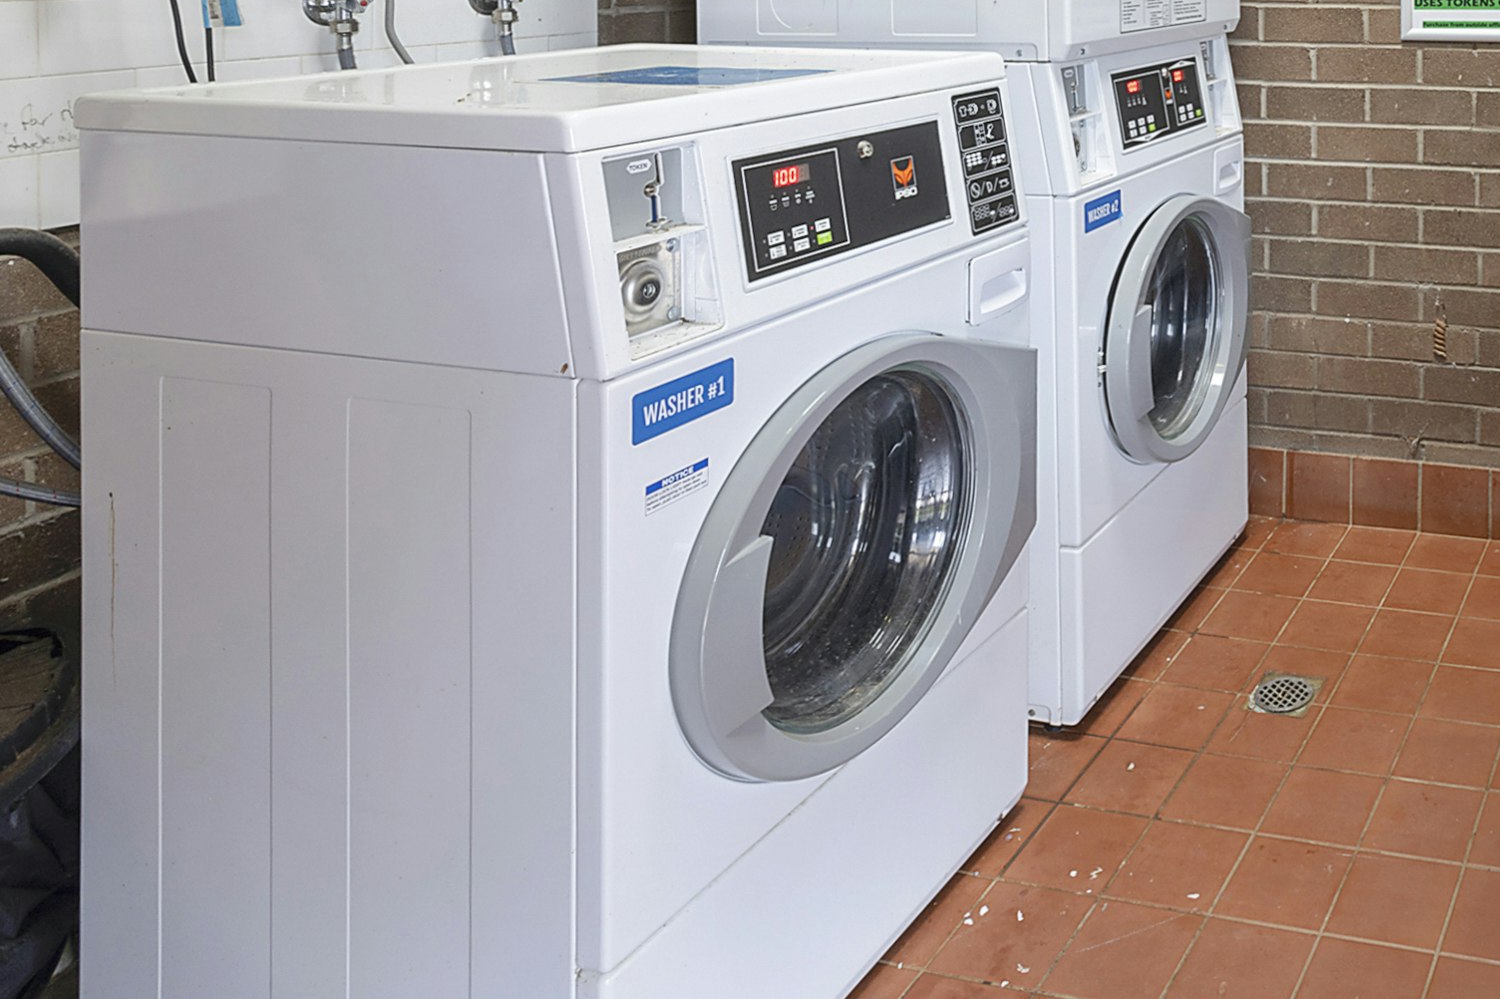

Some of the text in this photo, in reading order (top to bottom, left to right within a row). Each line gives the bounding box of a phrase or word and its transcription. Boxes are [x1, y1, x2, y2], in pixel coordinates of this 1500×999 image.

[775, 168, 797, 186] 100
[1088, 203, 1110, 223] WASHER
[644, 376, 725, 426] WASHER #1
[662, 466, 694, 487] NOTICE
